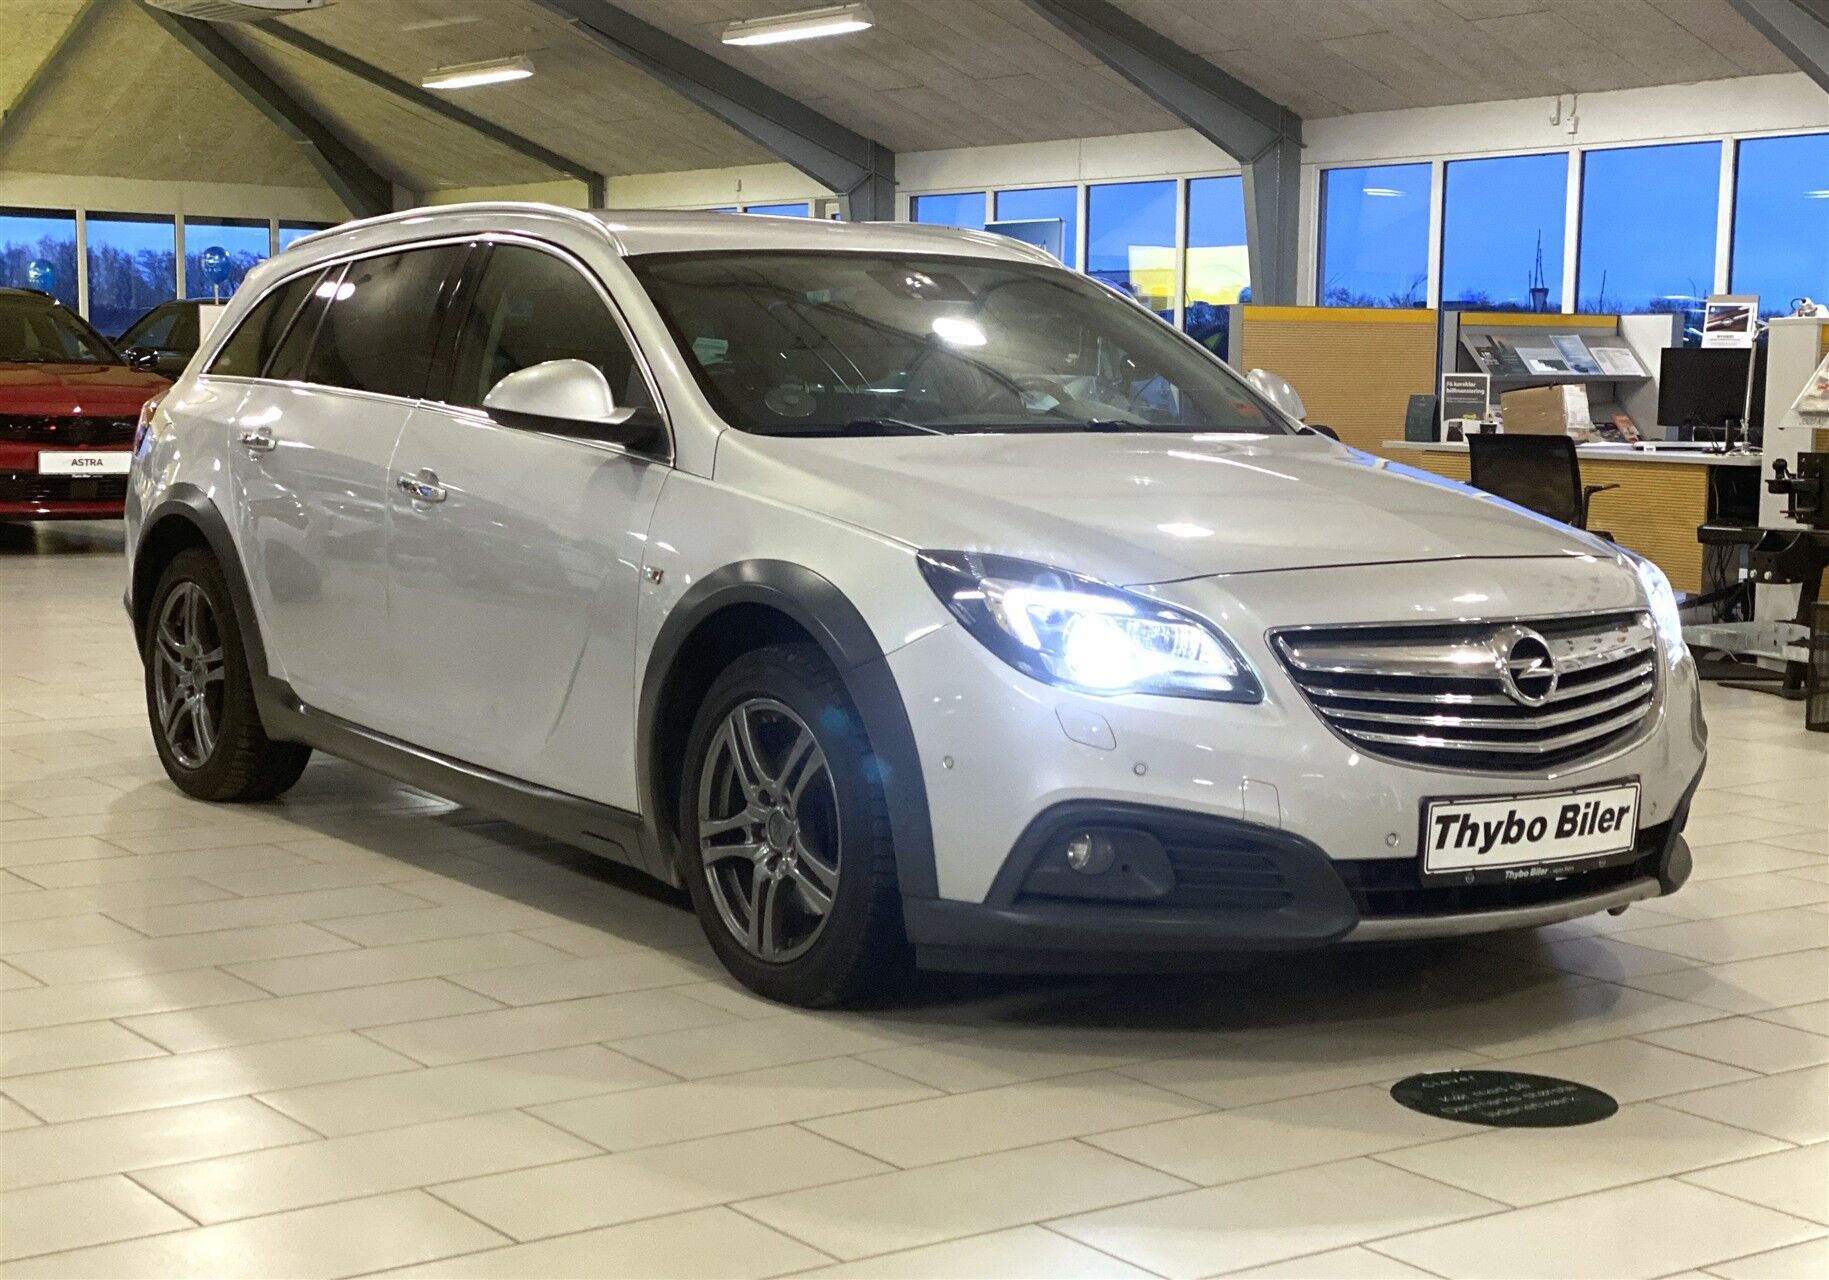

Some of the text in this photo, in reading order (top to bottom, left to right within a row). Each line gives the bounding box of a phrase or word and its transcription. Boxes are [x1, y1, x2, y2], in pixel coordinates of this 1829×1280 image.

[71, 458, 103, 466] ASTRA
[1435, 800, 1630, 855] Thybo Biler
[1505, 869, 1529, 880] Thybo
[1530, 867, 1549, 876] Biler
